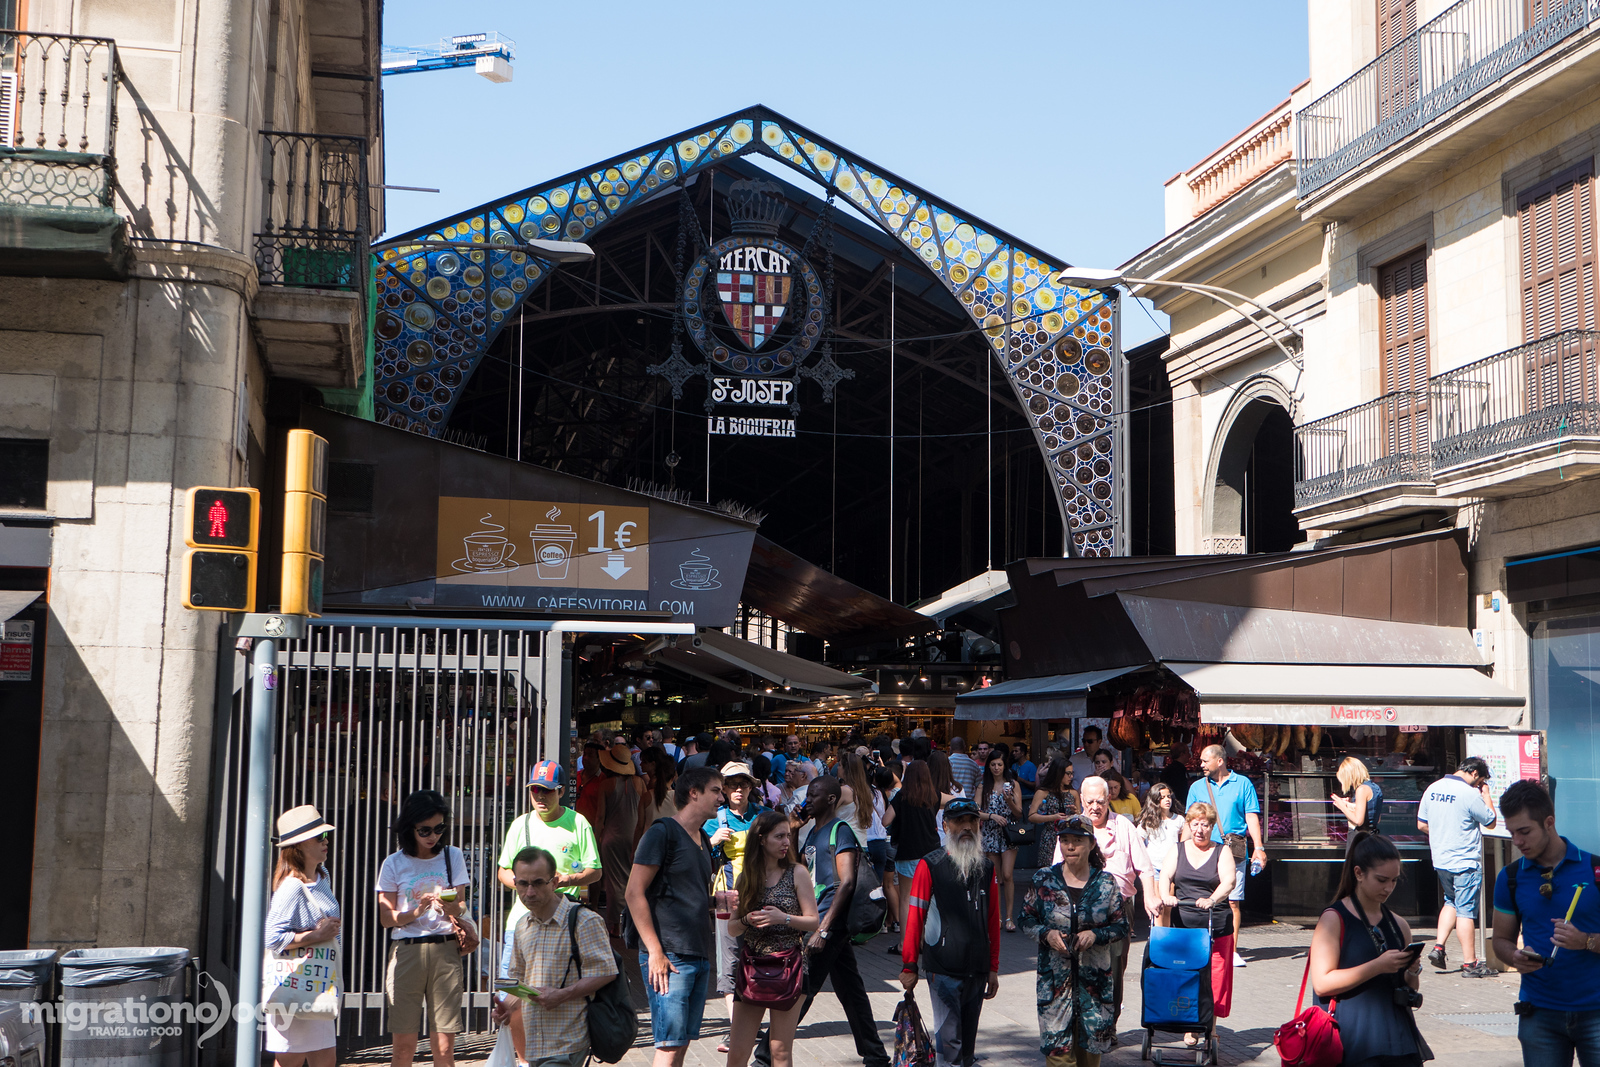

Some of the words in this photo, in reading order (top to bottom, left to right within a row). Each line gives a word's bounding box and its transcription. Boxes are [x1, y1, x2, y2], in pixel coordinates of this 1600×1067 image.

[719, 246, 790, 274] MERCAT
[730, 379, 794, 405] JOSEP
[708, 416, 726, 435] LA
[729, 416, 796, 438] BOQUERIA
[587, 510, 637, 553] 1€
[542, 551, 564, 559] Coffee
[481, 595, 526, 608] WWW
[537, 596, 648, 611] CAFESVITORIA
[659, 600, 695, 616] COM
[1330, 706, 1382, 720] Marcos
[1430, 791, 1456, 804] STAFF
